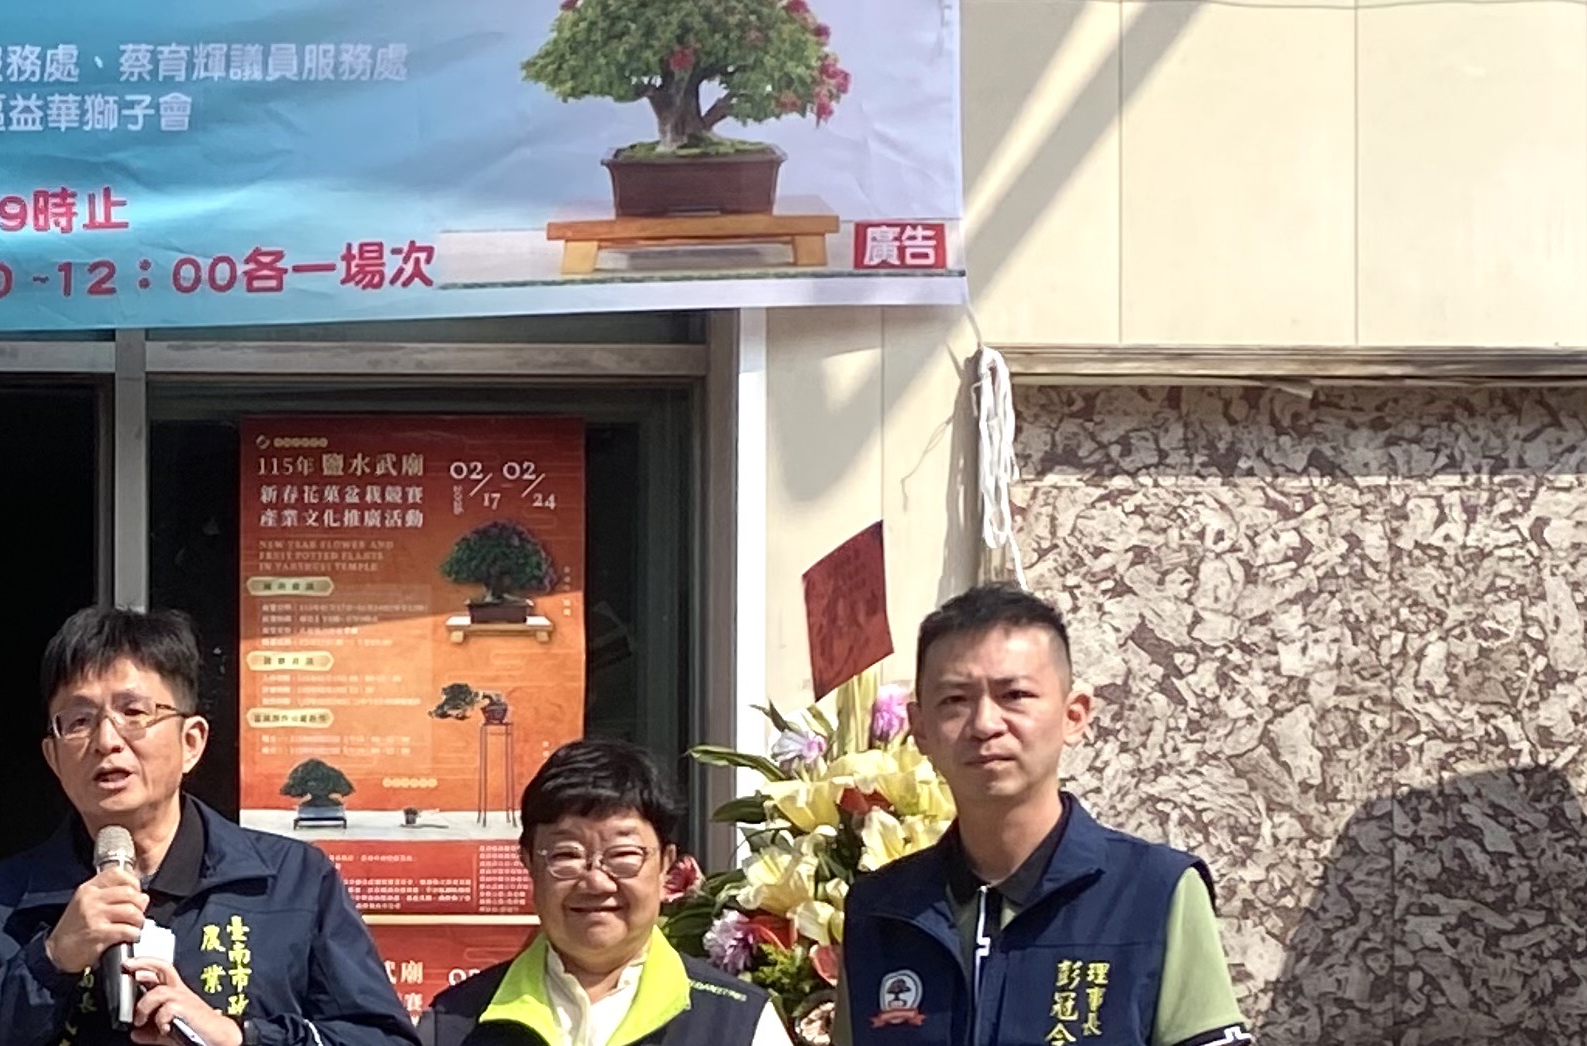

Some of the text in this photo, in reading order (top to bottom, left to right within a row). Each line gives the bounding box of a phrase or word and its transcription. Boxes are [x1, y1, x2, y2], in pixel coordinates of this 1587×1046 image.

[863, 223, 938, 268] 廣告
[258, 453, 424, 477] 115年 鹽水武廟
[259, 484, 423, 505] 新春花菓盆栽競賽
[259, 507, 424, 529] 產業文化推廣活動
[1081, 962, 1111, 1036] 理事長
